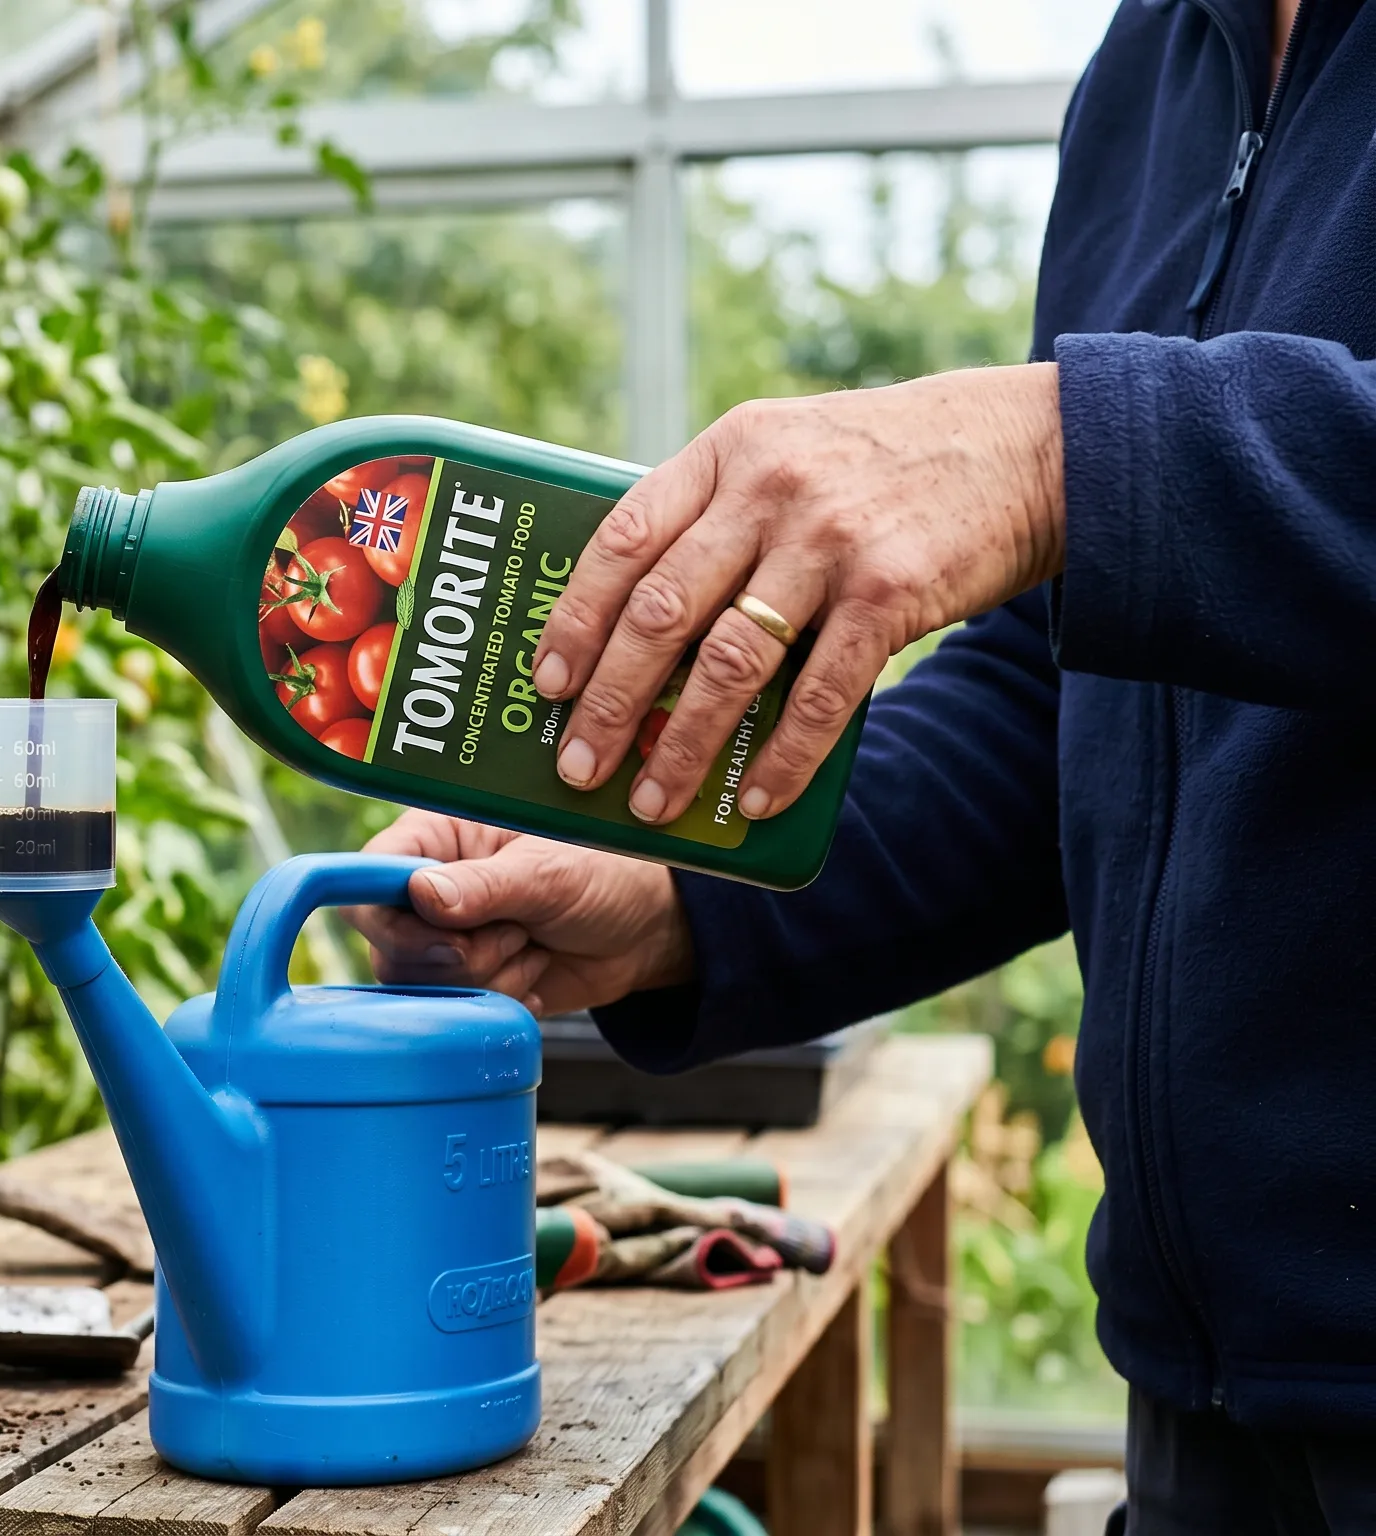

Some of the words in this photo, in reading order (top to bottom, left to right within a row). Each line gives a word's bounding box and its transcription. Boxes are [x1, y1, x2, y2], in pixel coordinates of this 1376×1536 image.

[392, 489, 505, 755] TOMORITE
[459, 630, 505, 765] CONCENTRATED
[492, 555, 524, 626] TOMATO
[512, 502, 537, 551] FOOD
[13, 740, 56, 756] 60ml
[714, 792, 735, 825] FOR
[725, 718, 755, 788] HEALTHY
[13, 773, 56, 788] 60ml
[15, 839, 56, 855] 20ml
[443, 1132, 468, 1192] 5
